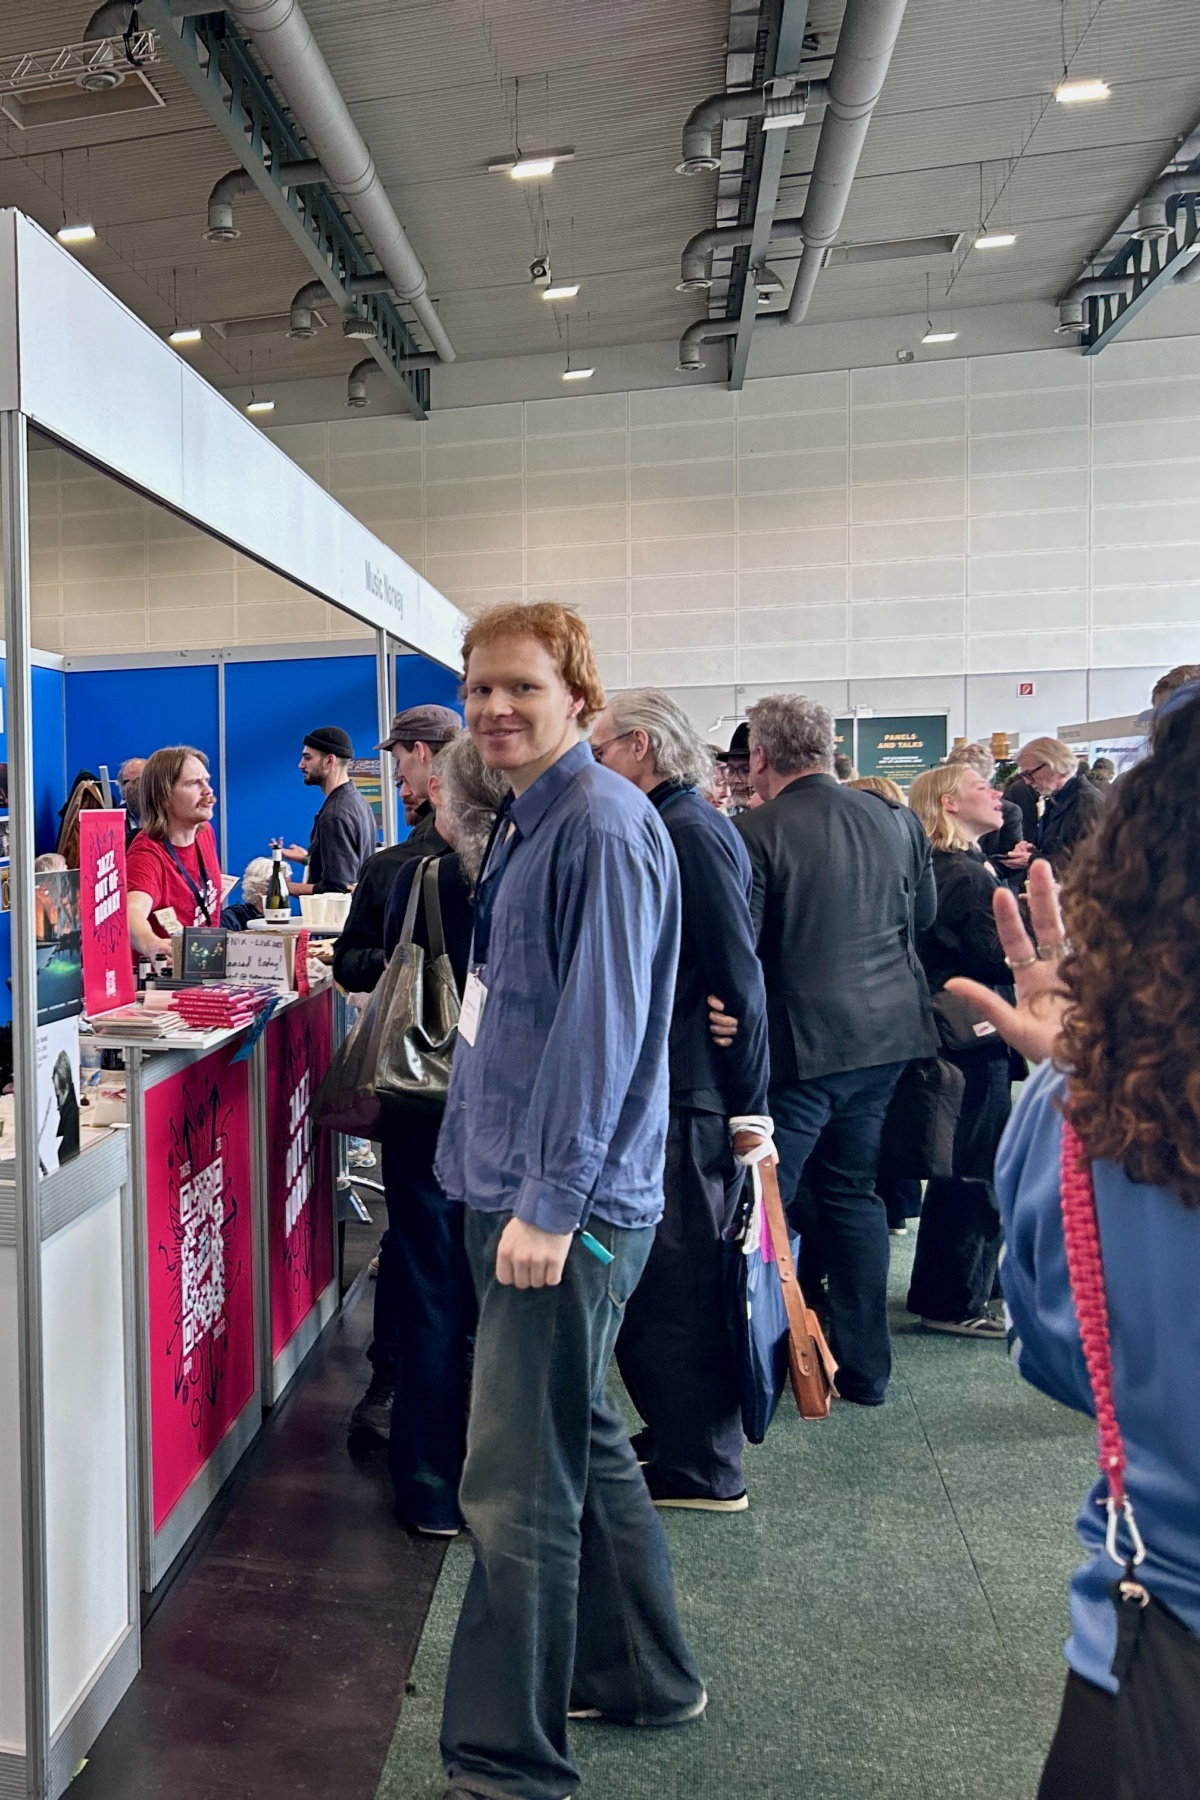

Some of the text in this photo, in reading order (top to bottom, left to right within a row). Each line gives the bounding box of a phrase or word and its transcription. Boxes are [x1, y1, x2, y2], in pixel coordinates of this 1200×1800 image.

[365, 559, 404, 621] Music Norway
[884, 733, 917, 741] PANELS
[898, 741, 924, 749] TALKS
